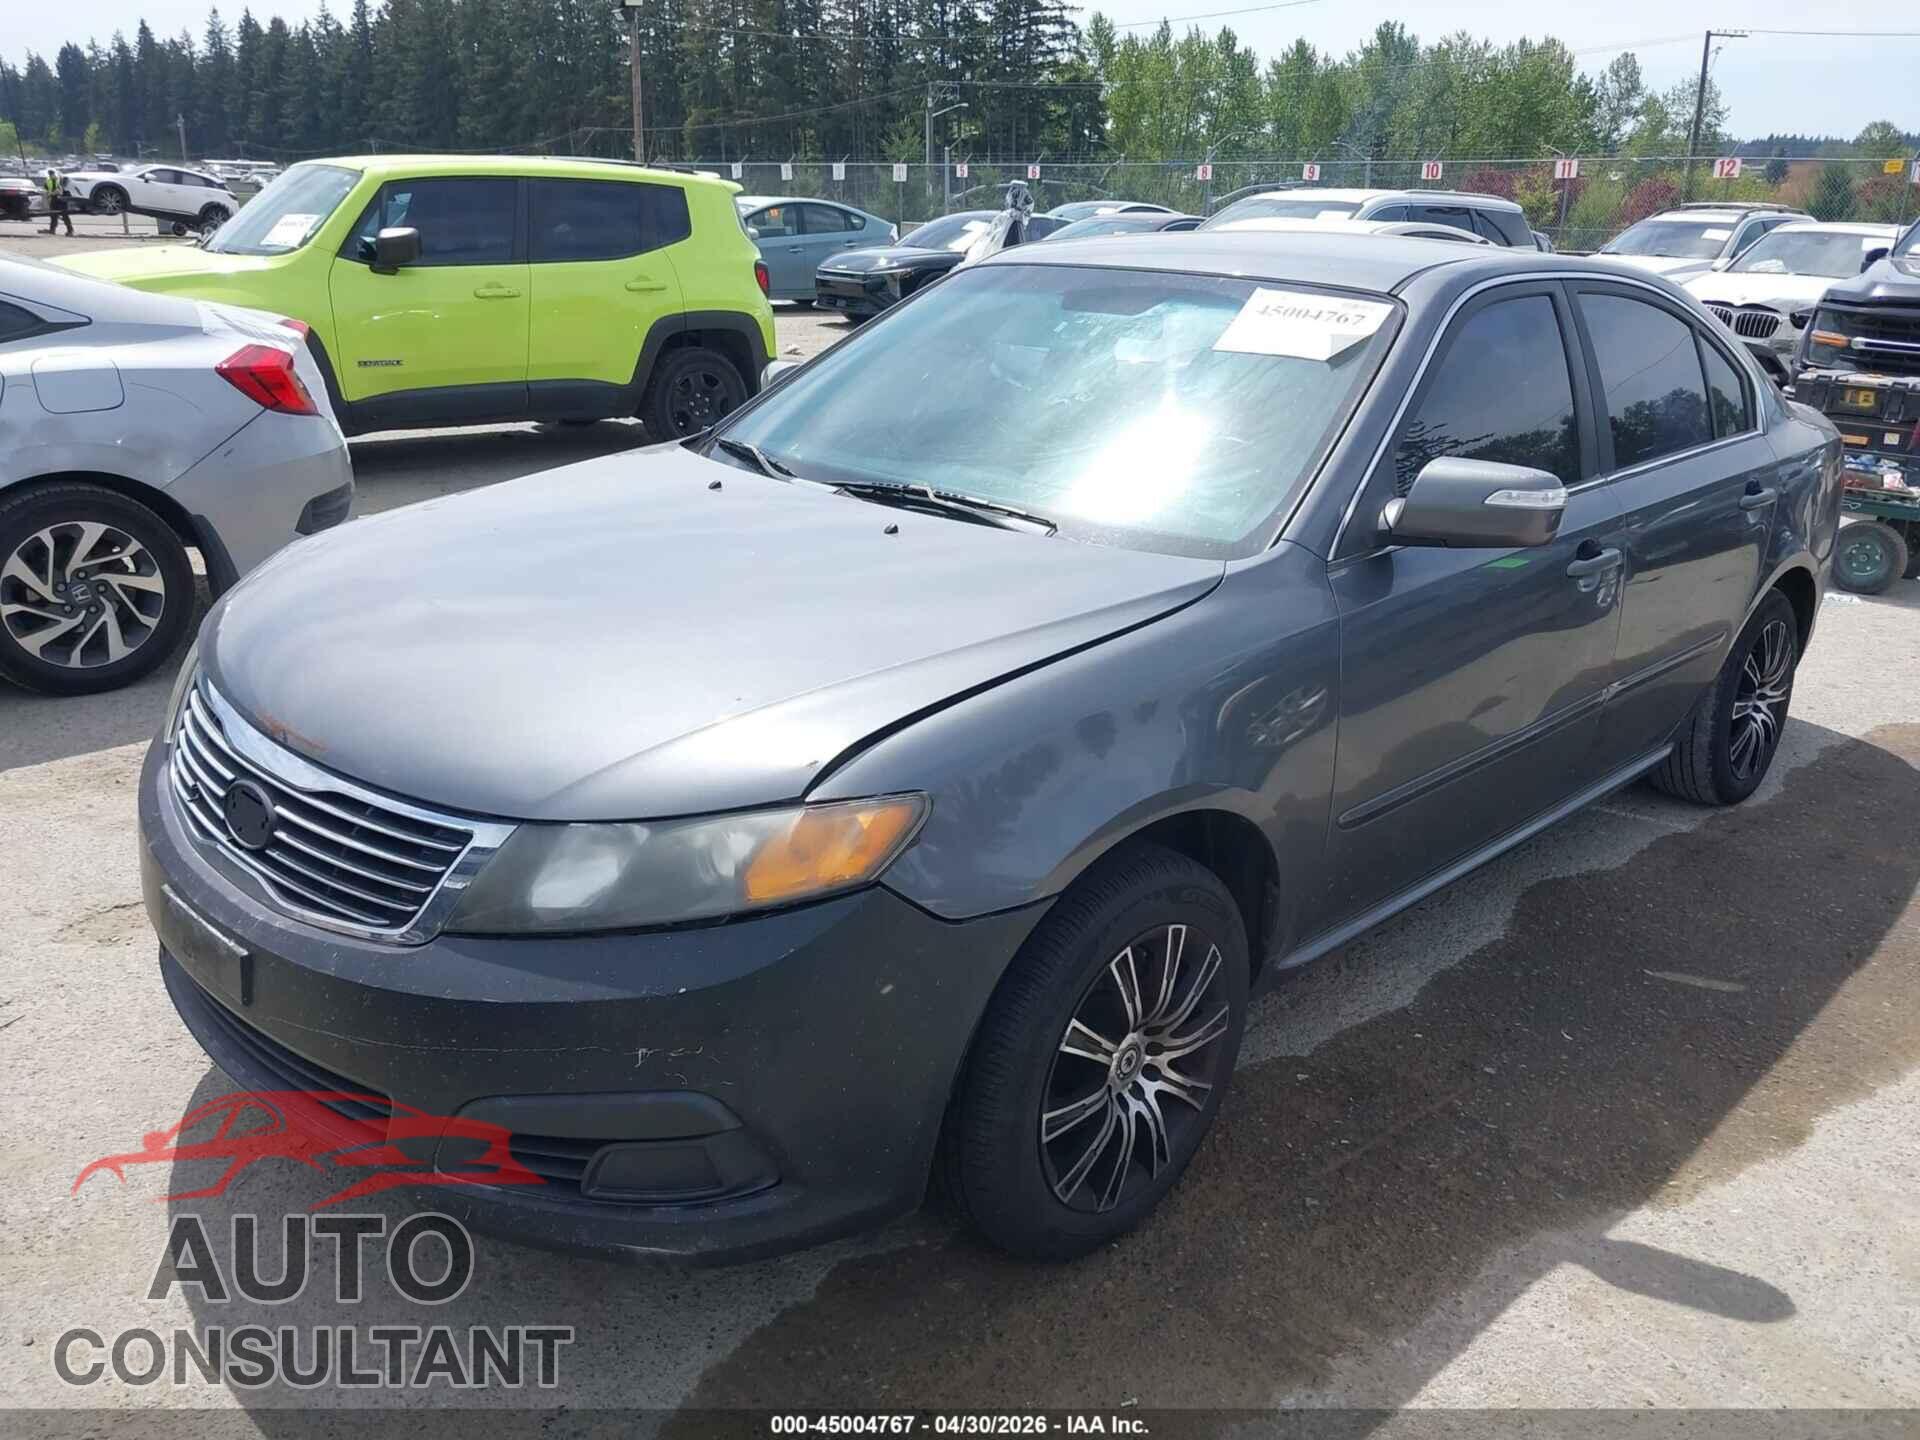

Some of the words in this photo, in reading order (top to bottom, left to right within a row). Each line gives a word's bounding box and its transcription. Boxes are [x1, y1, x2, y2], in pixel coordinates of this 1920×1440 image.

[959, 165, 966, 177] 5
[1201, 166, 1208, 179] 8
[1307, 165, 1316, 179] 9
[1426, 163, 1439, 178] 10
[1561, 161, 1572, 177] 11
[1719, 160, 1736, 176] 12
[1257, 304, 1366, 326] 45004767
